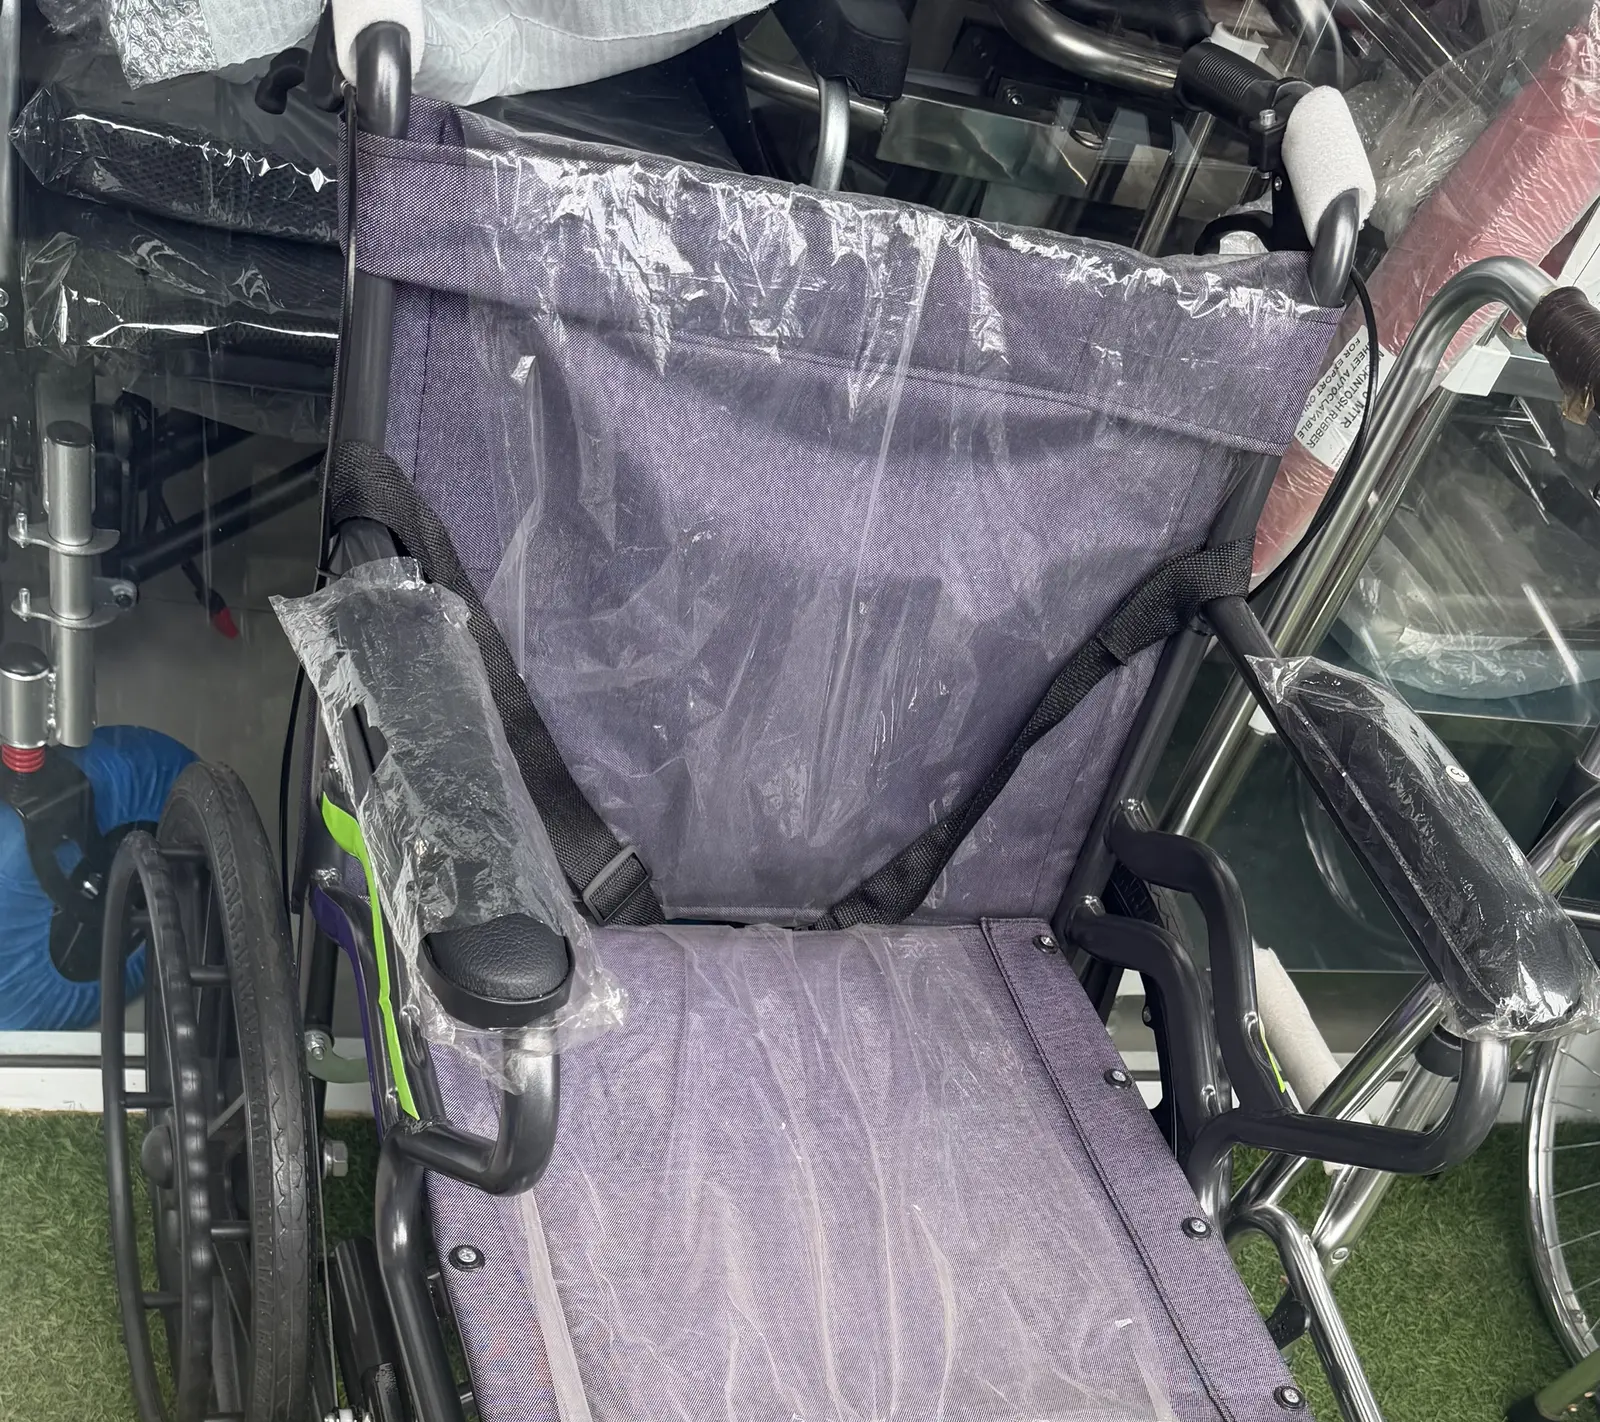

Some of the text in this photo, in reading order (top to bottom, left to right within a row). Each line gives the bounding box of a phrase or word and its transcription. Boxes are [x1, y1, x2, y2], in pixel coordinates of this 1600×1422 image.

[1343, 338, 1361, 358] FOR
[1351, 342, 1370, 372] HEET
[1317, 358, 1344, 396] EXPORT
[1297, 369, 1350, 439] AUTOCLAVABLE
[1306, 350, 1385, 448] MCKINTOSH RUBBER
[1340, 400, 1365, 429] MTR
